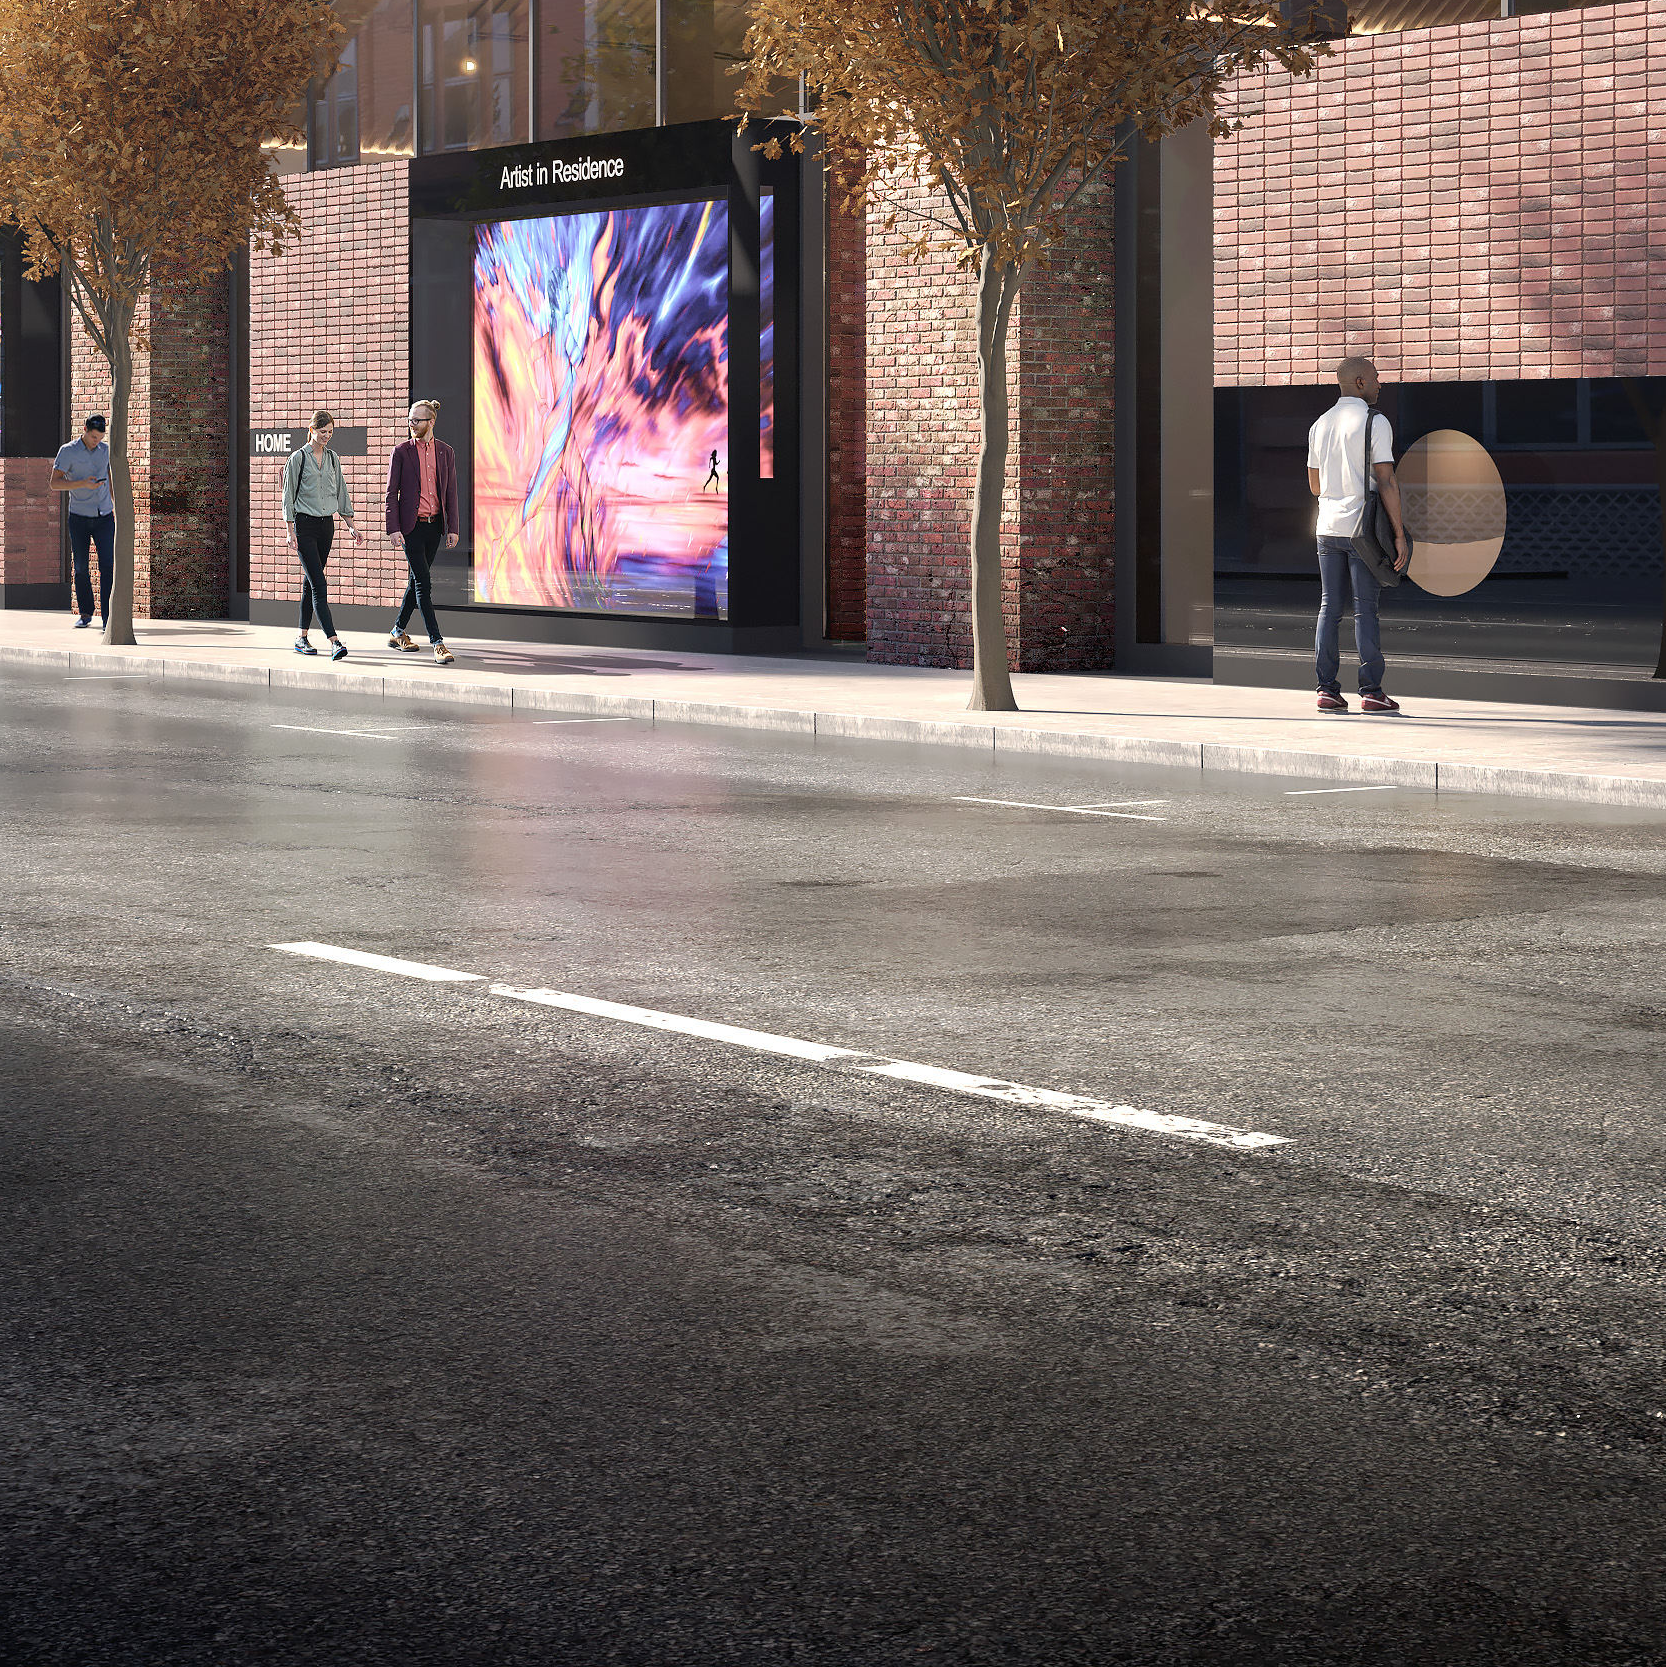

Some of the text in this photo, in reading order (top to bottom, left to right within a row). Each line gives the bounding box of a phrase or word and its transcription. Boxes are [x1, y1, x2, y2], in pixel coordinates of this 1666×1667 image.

[499, 155, 625, 190] Artist in Residence
[255, 433, 292, 453] HOME
